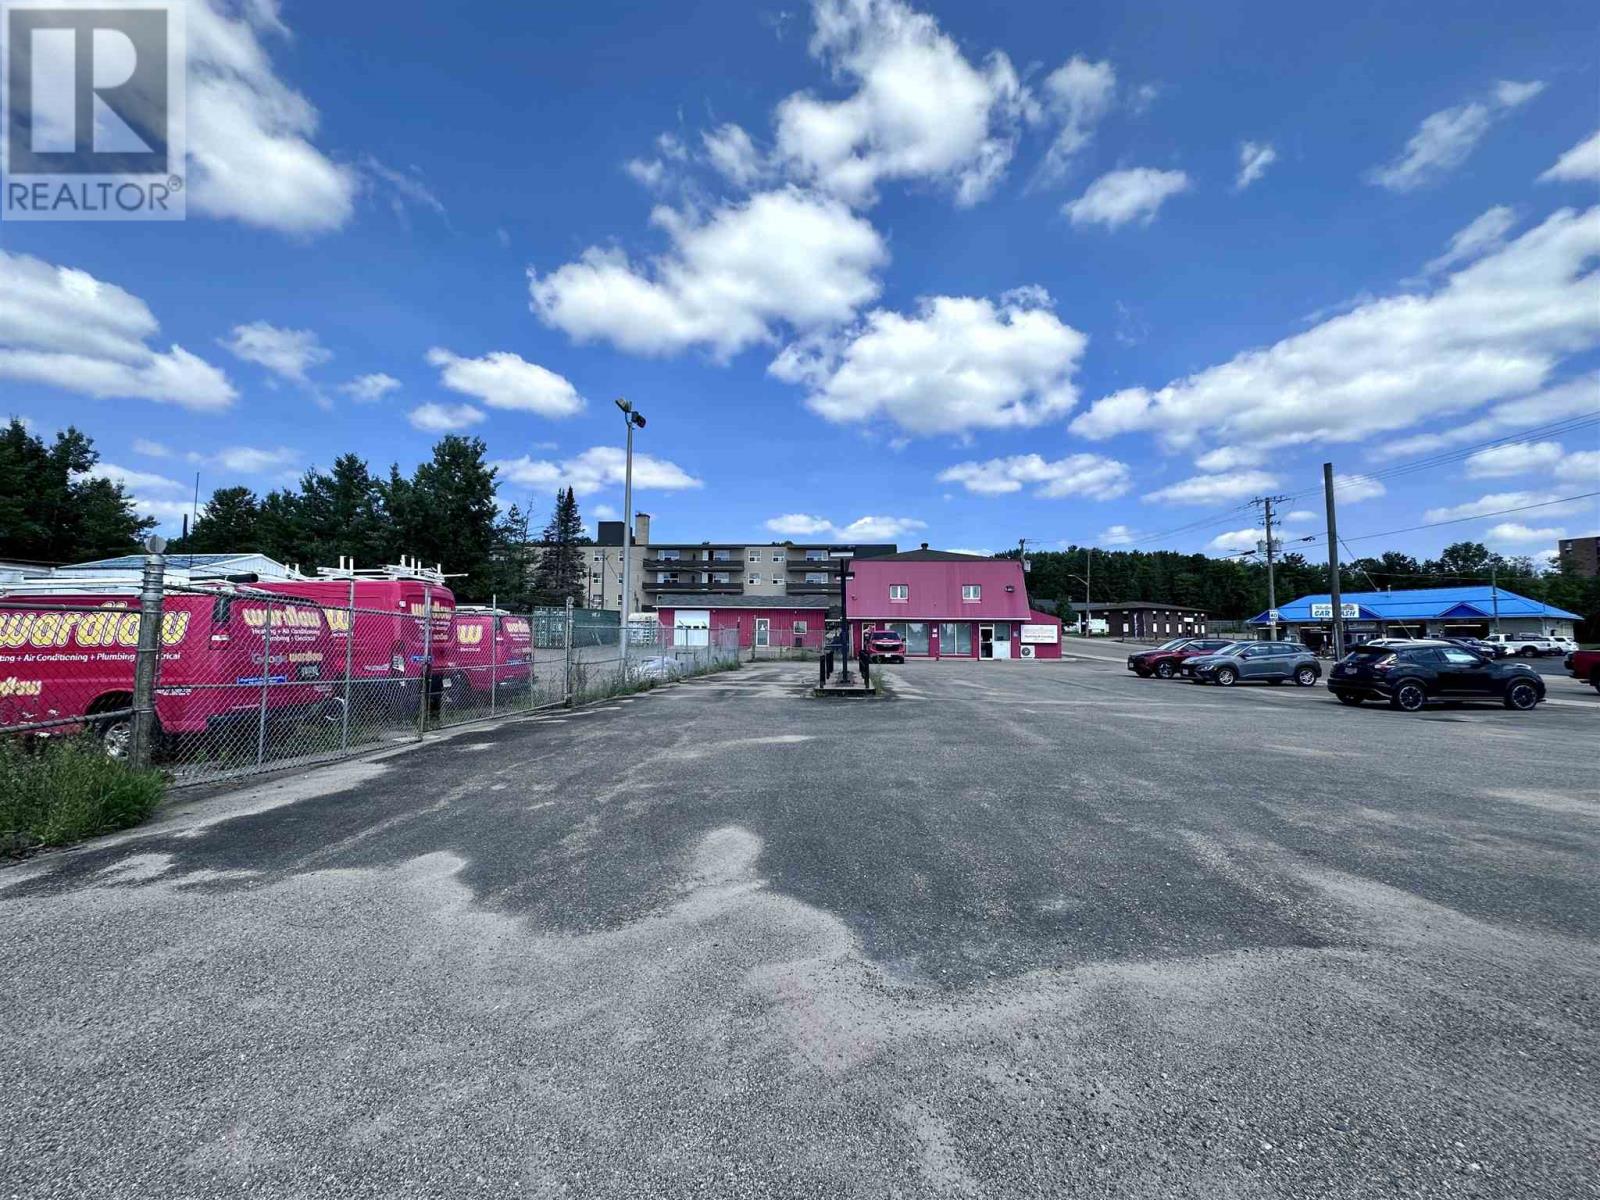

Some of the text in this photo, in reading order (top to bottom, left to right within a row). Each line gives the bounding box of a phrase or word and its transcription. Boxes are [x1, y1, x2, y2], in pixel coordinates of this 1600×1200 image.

[24, 653, 36, 662] Air
[36, 653, 89, 663] Conditioning
[96, 652, 136, 662] Plumbing
